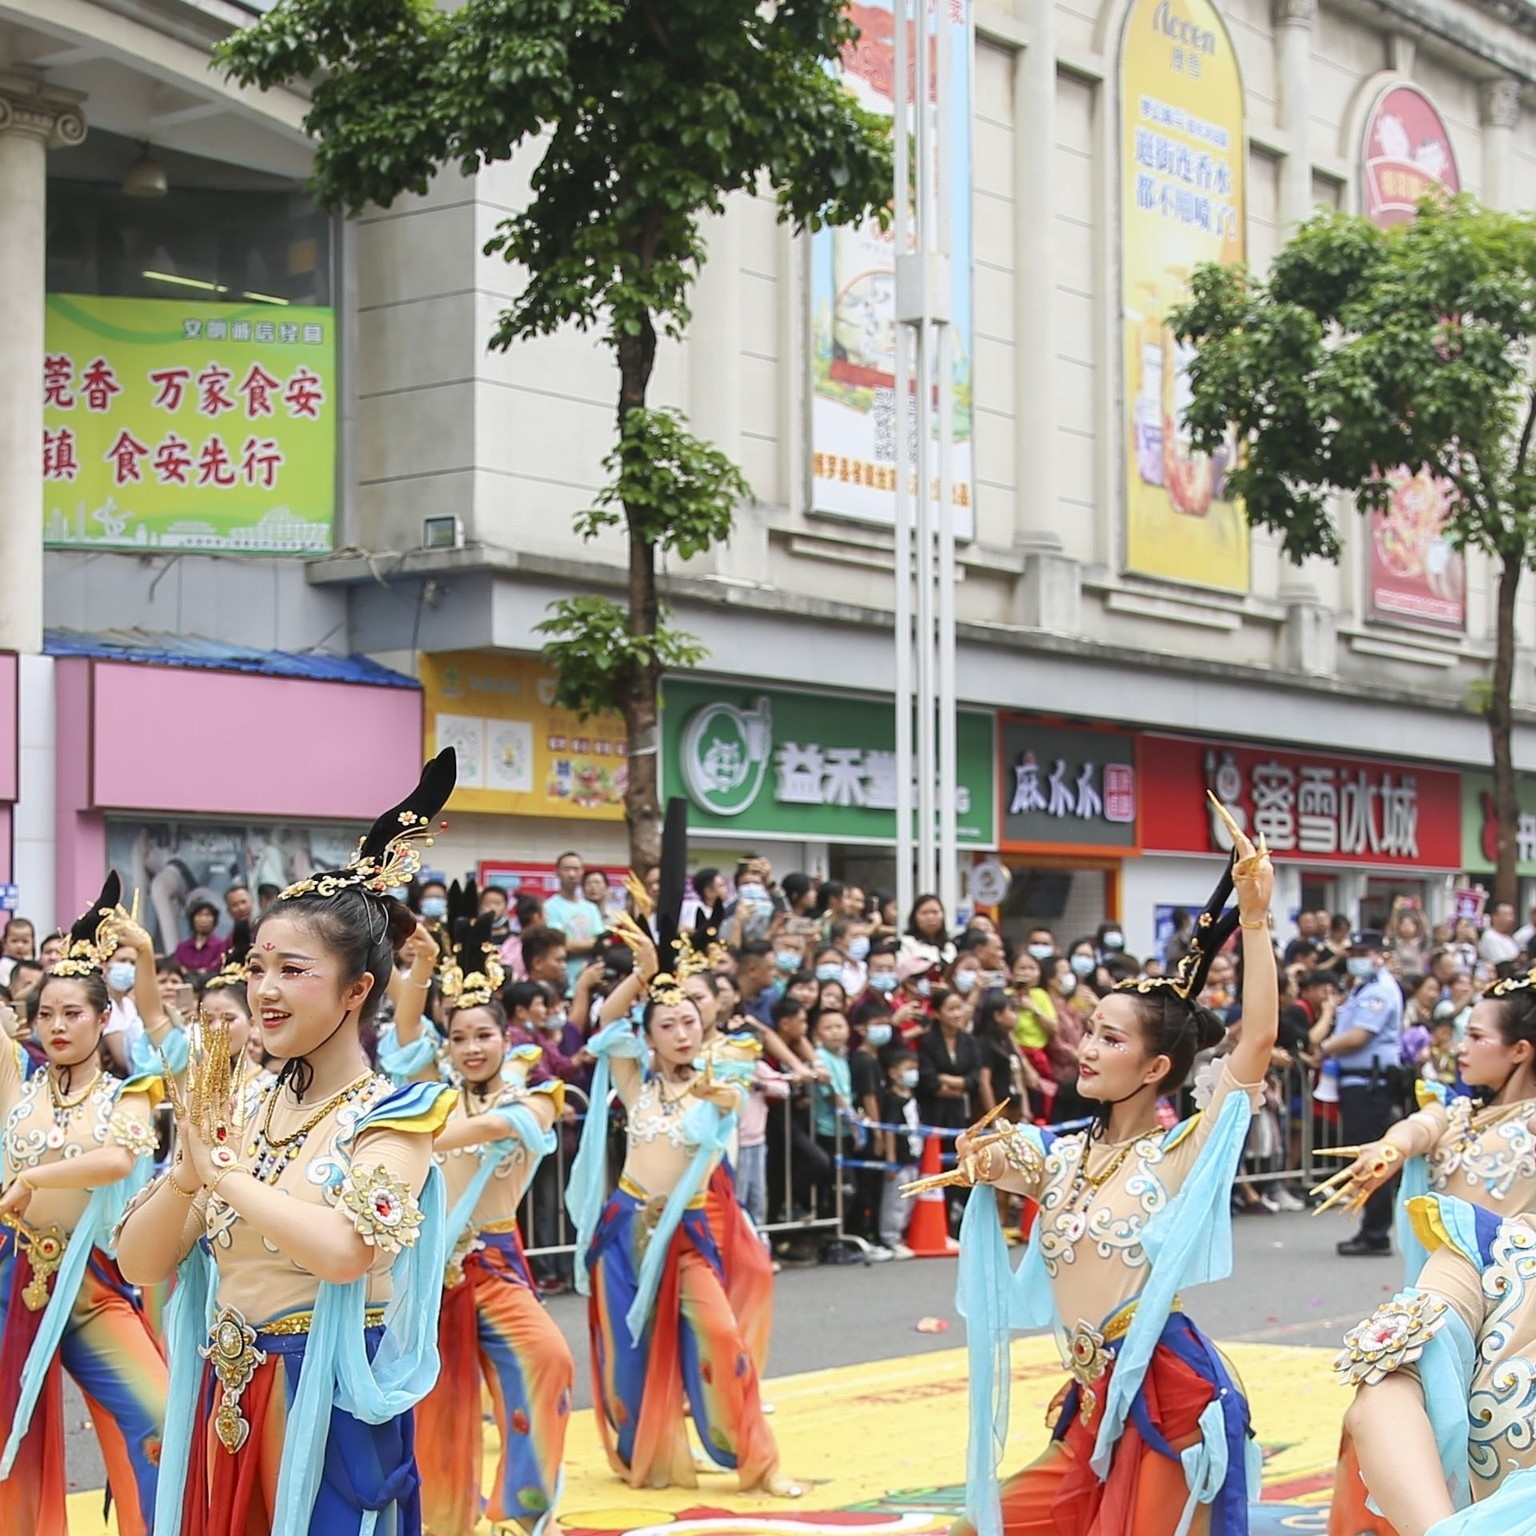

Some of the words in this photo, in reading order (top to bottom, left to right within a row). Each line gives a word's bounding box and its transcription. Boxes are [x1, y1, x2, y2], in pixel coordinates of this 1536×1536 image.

[151, 364, 324, 418] 万家食安
[108, 431, 283, 488] 食安先行
[1252, 760, 1419, 860] 蜜雪冰城
